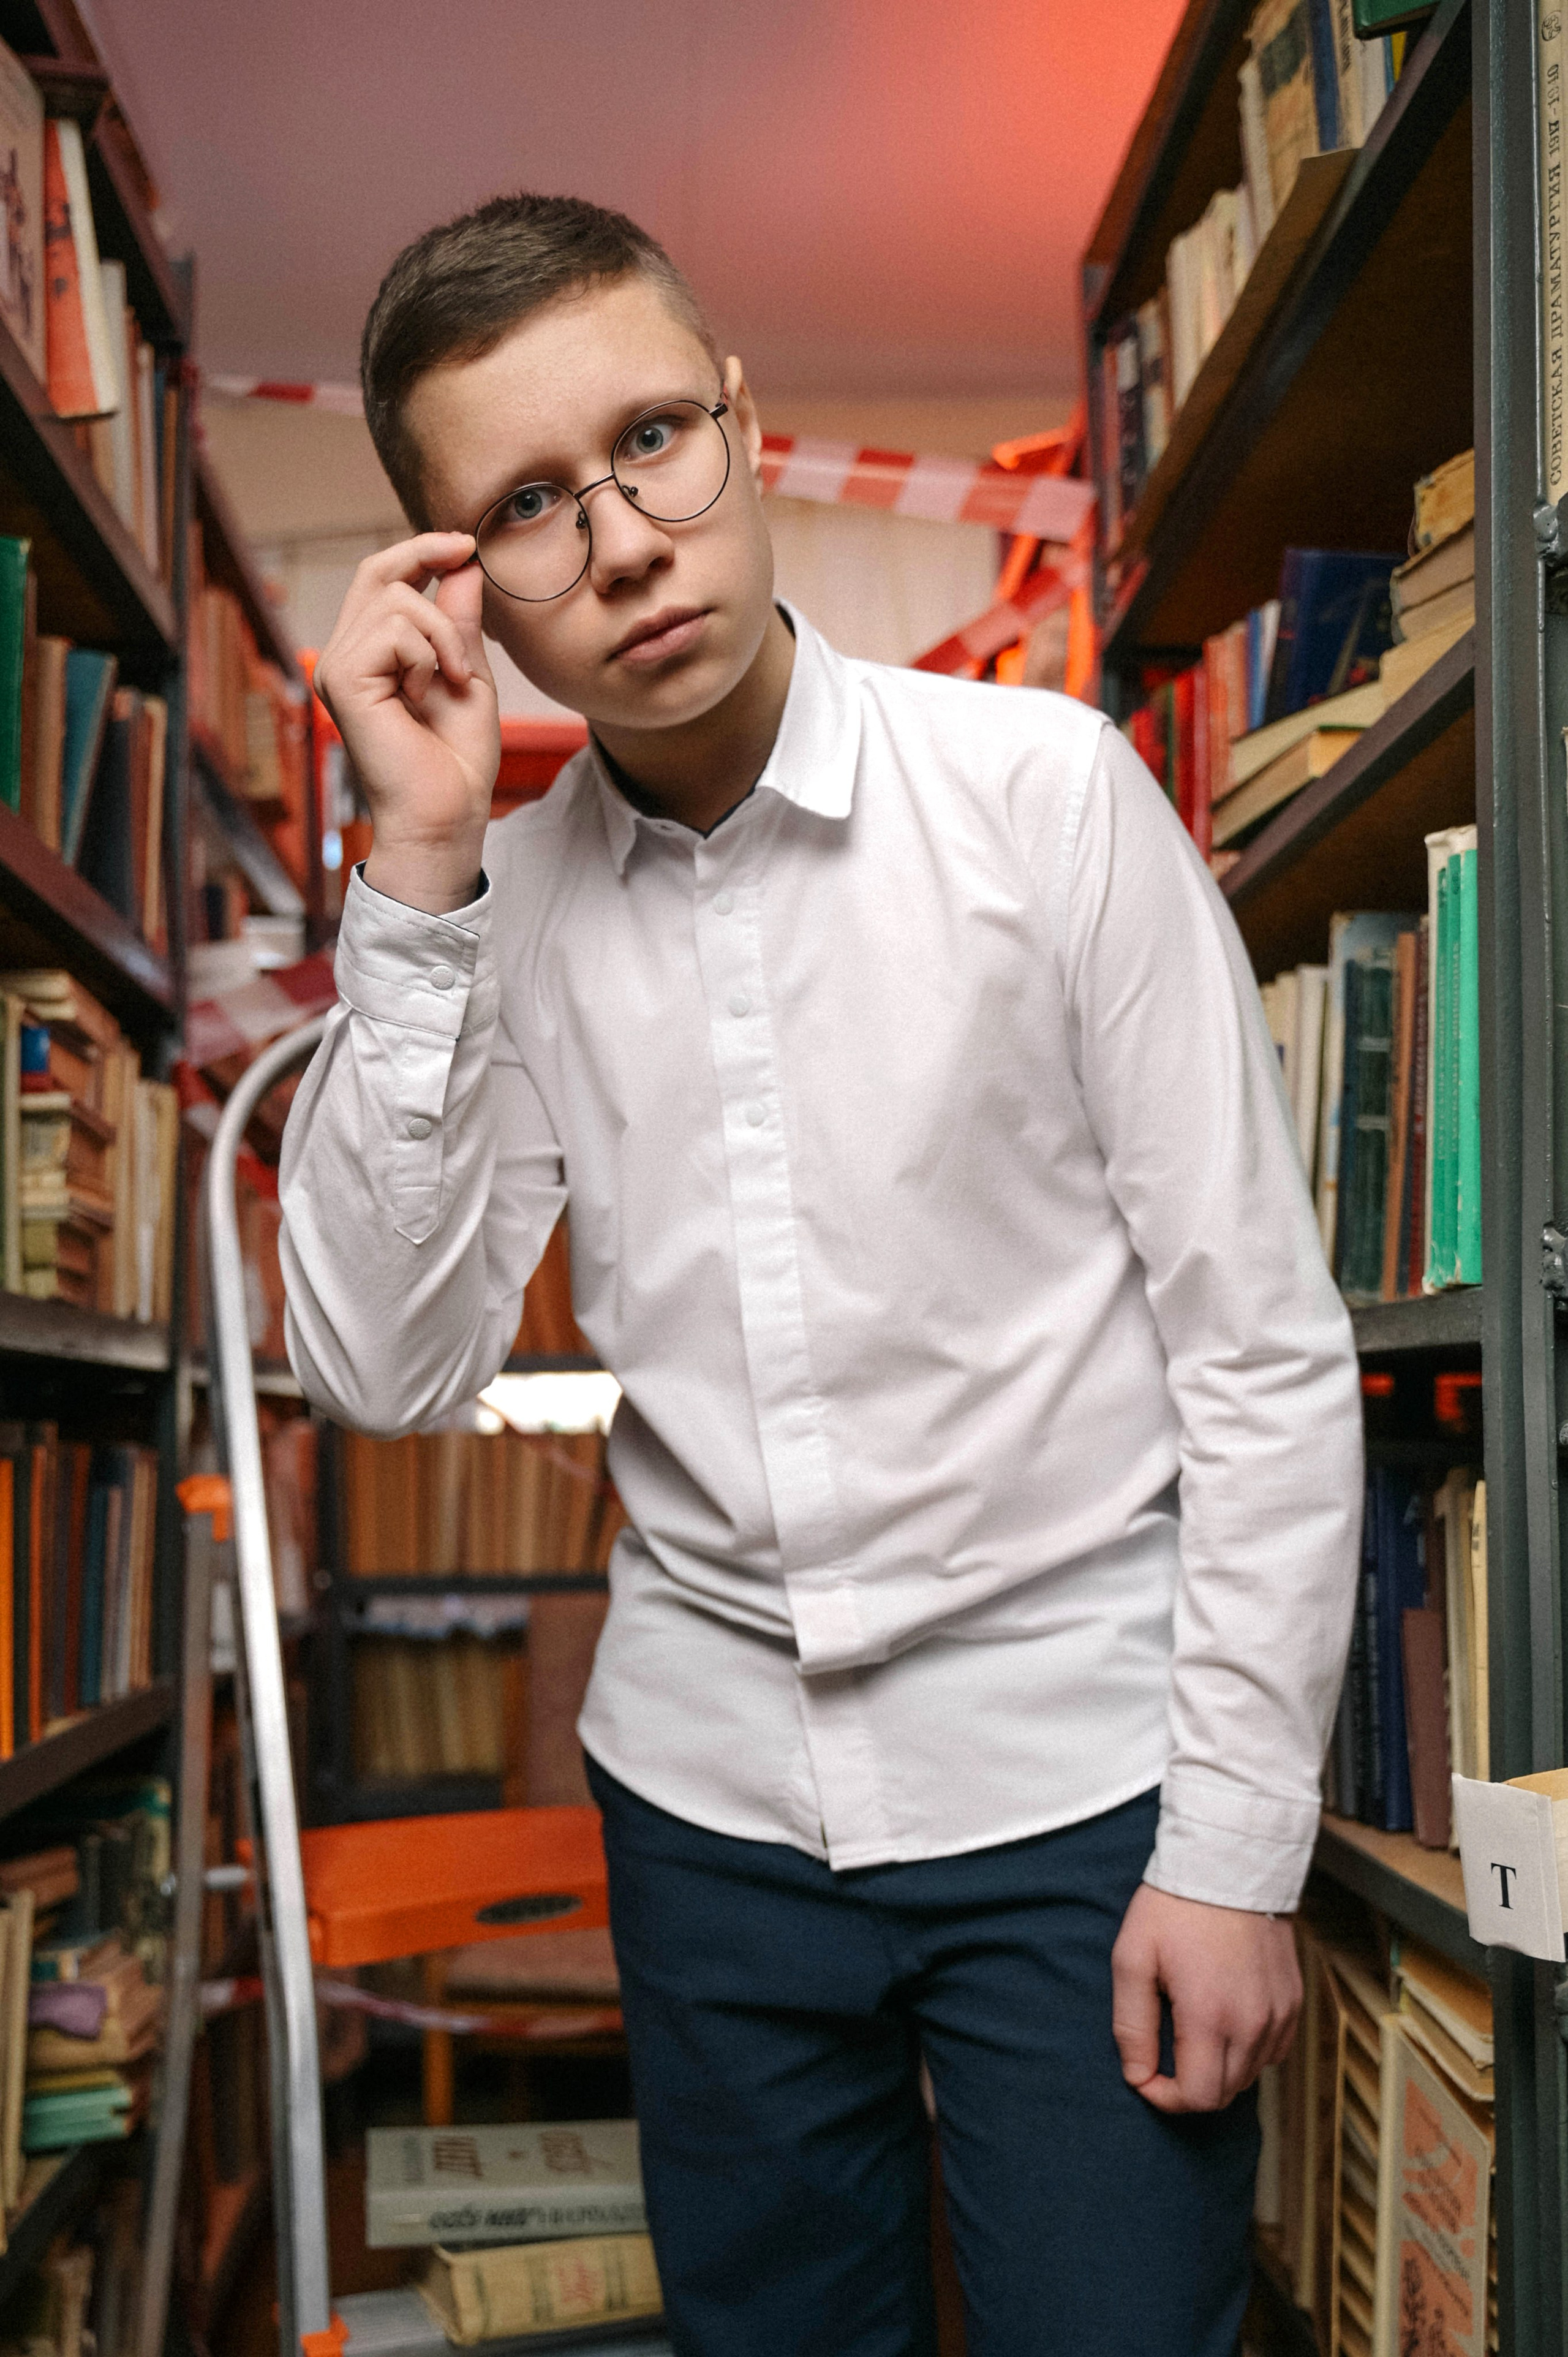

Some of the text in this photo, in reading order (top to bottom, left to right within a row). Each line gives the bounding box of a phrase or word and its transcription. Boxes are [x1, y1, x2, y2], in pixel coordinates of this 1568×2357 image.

[1548, 162, 1563, 341] ДРАМАТУРГИЯ
[1550, 345, 1562, 486] СОВЕТСКАЯ
[1490, 1862, 1517, 1910] Т
